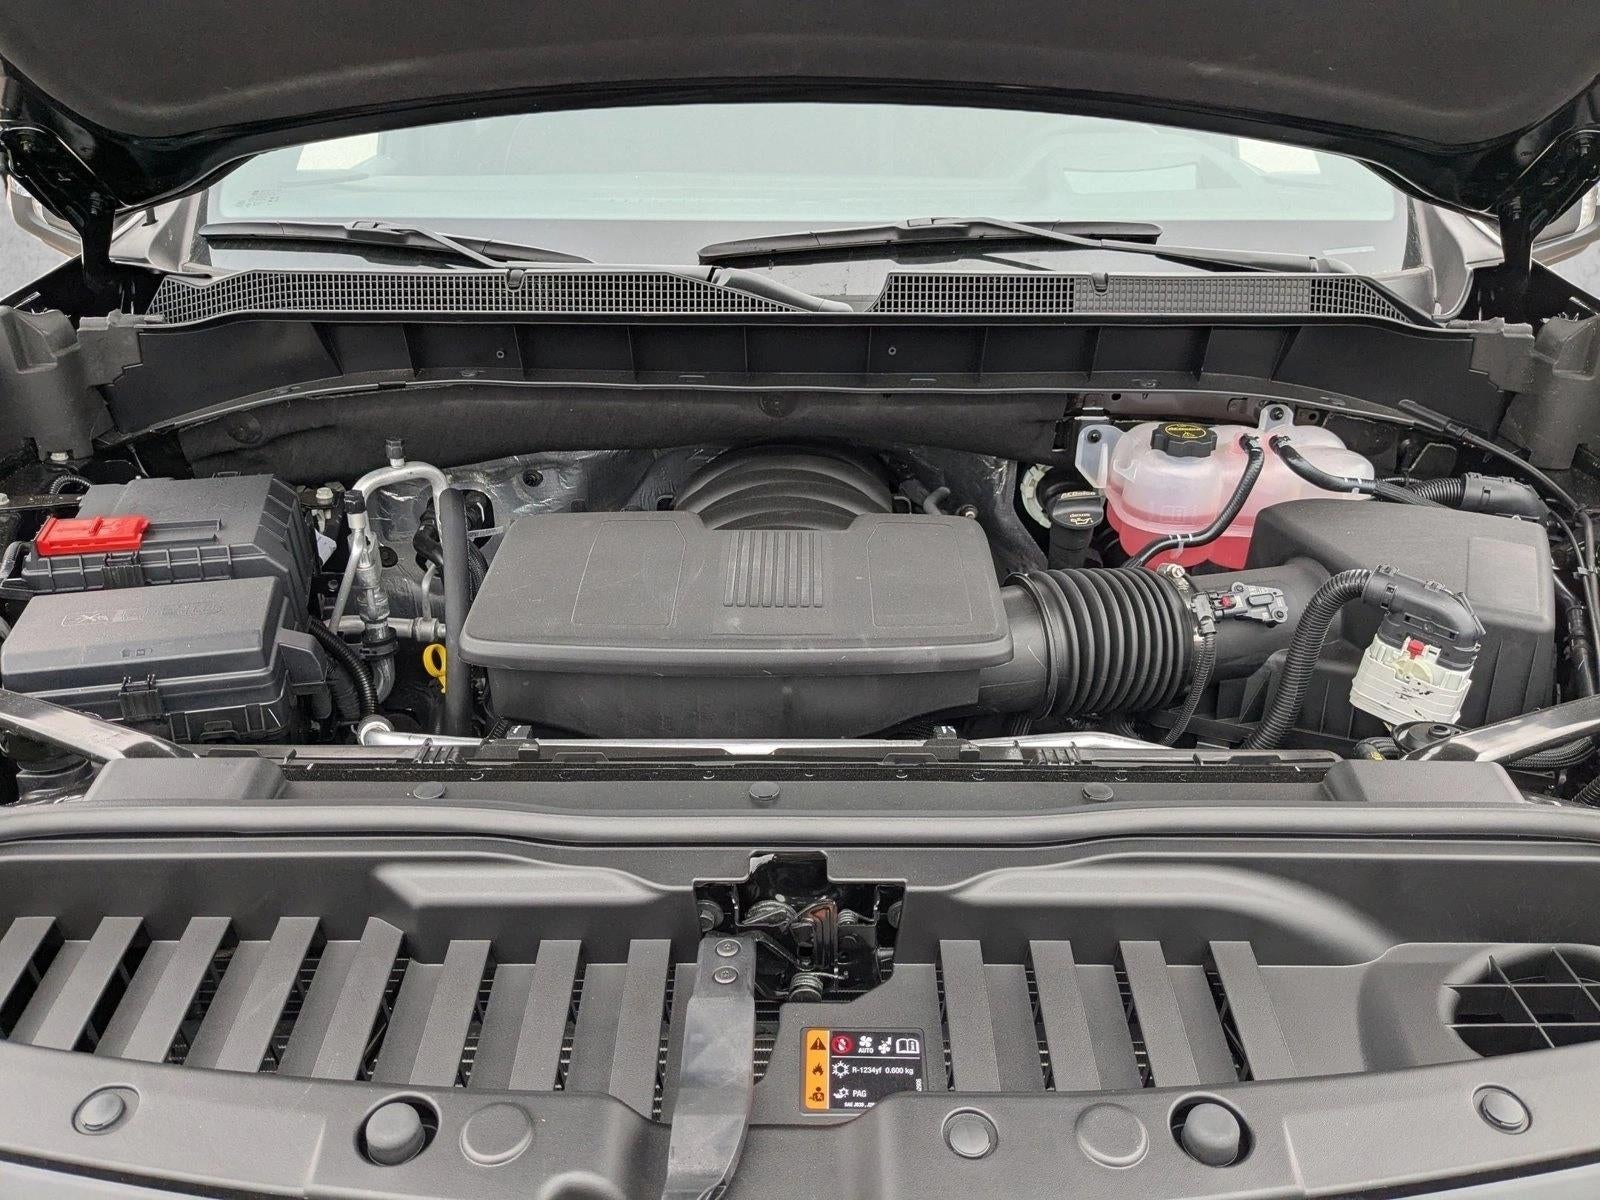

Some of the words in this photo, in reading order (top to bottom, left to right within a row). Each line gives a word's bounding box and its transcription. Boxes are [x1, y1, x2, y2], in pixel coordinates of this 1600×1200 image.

[852, 1066, 882, 1075] R-1234yf
[885, 1066, 904, 1074] 0.600
[905, 1067, 914, 1075] kg
[852, 1090, 867, 1098] PAG
